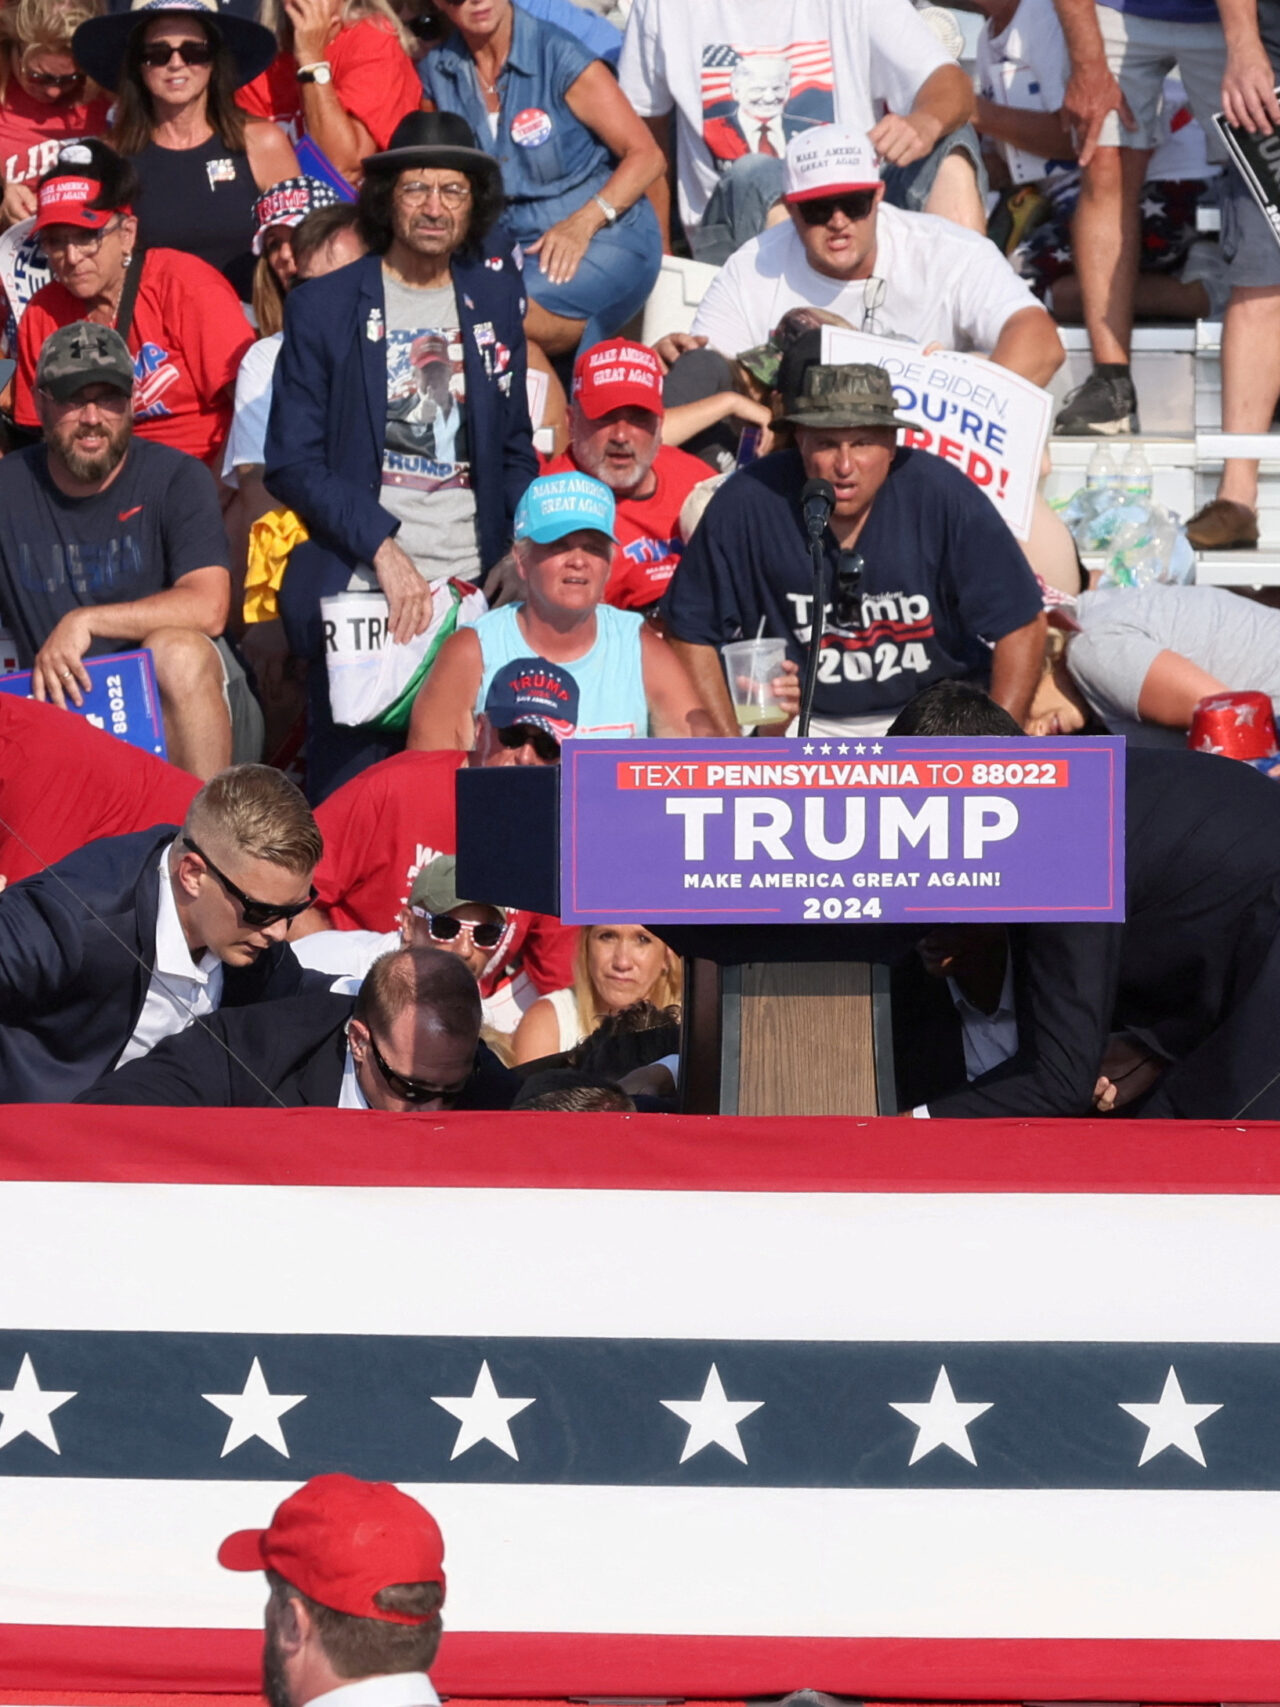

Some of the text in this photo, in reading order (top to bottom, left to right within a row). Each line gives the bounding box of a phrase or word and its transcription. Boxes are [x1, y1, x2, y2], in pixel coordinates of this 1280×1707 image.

[824, 146, 863, 158] AMERICA
[588, 348, 618, 368] MAKE
[877, 356, 926, 383] JOE
[593, 367, 626, 387] GREAT
[532, 479, 566, 500] MAKE
[541, 496, 577, 516] GREAT
[786, 593, 930, 633] Trmp
[816, 642, 932, 684] 2024
[508, 674, 571, 702] TRUMP
[106, 673, 128, 735] 88022
[629, 762, 1057, 787] TEXT PENNSYLVANIA TO 88022
[665, 795, 1019, 862] TRUMP
[683, 871, 1001, 889] MAKE AMERICA GREAT AGAIN!
[803, 897, 882, 920] 2024
